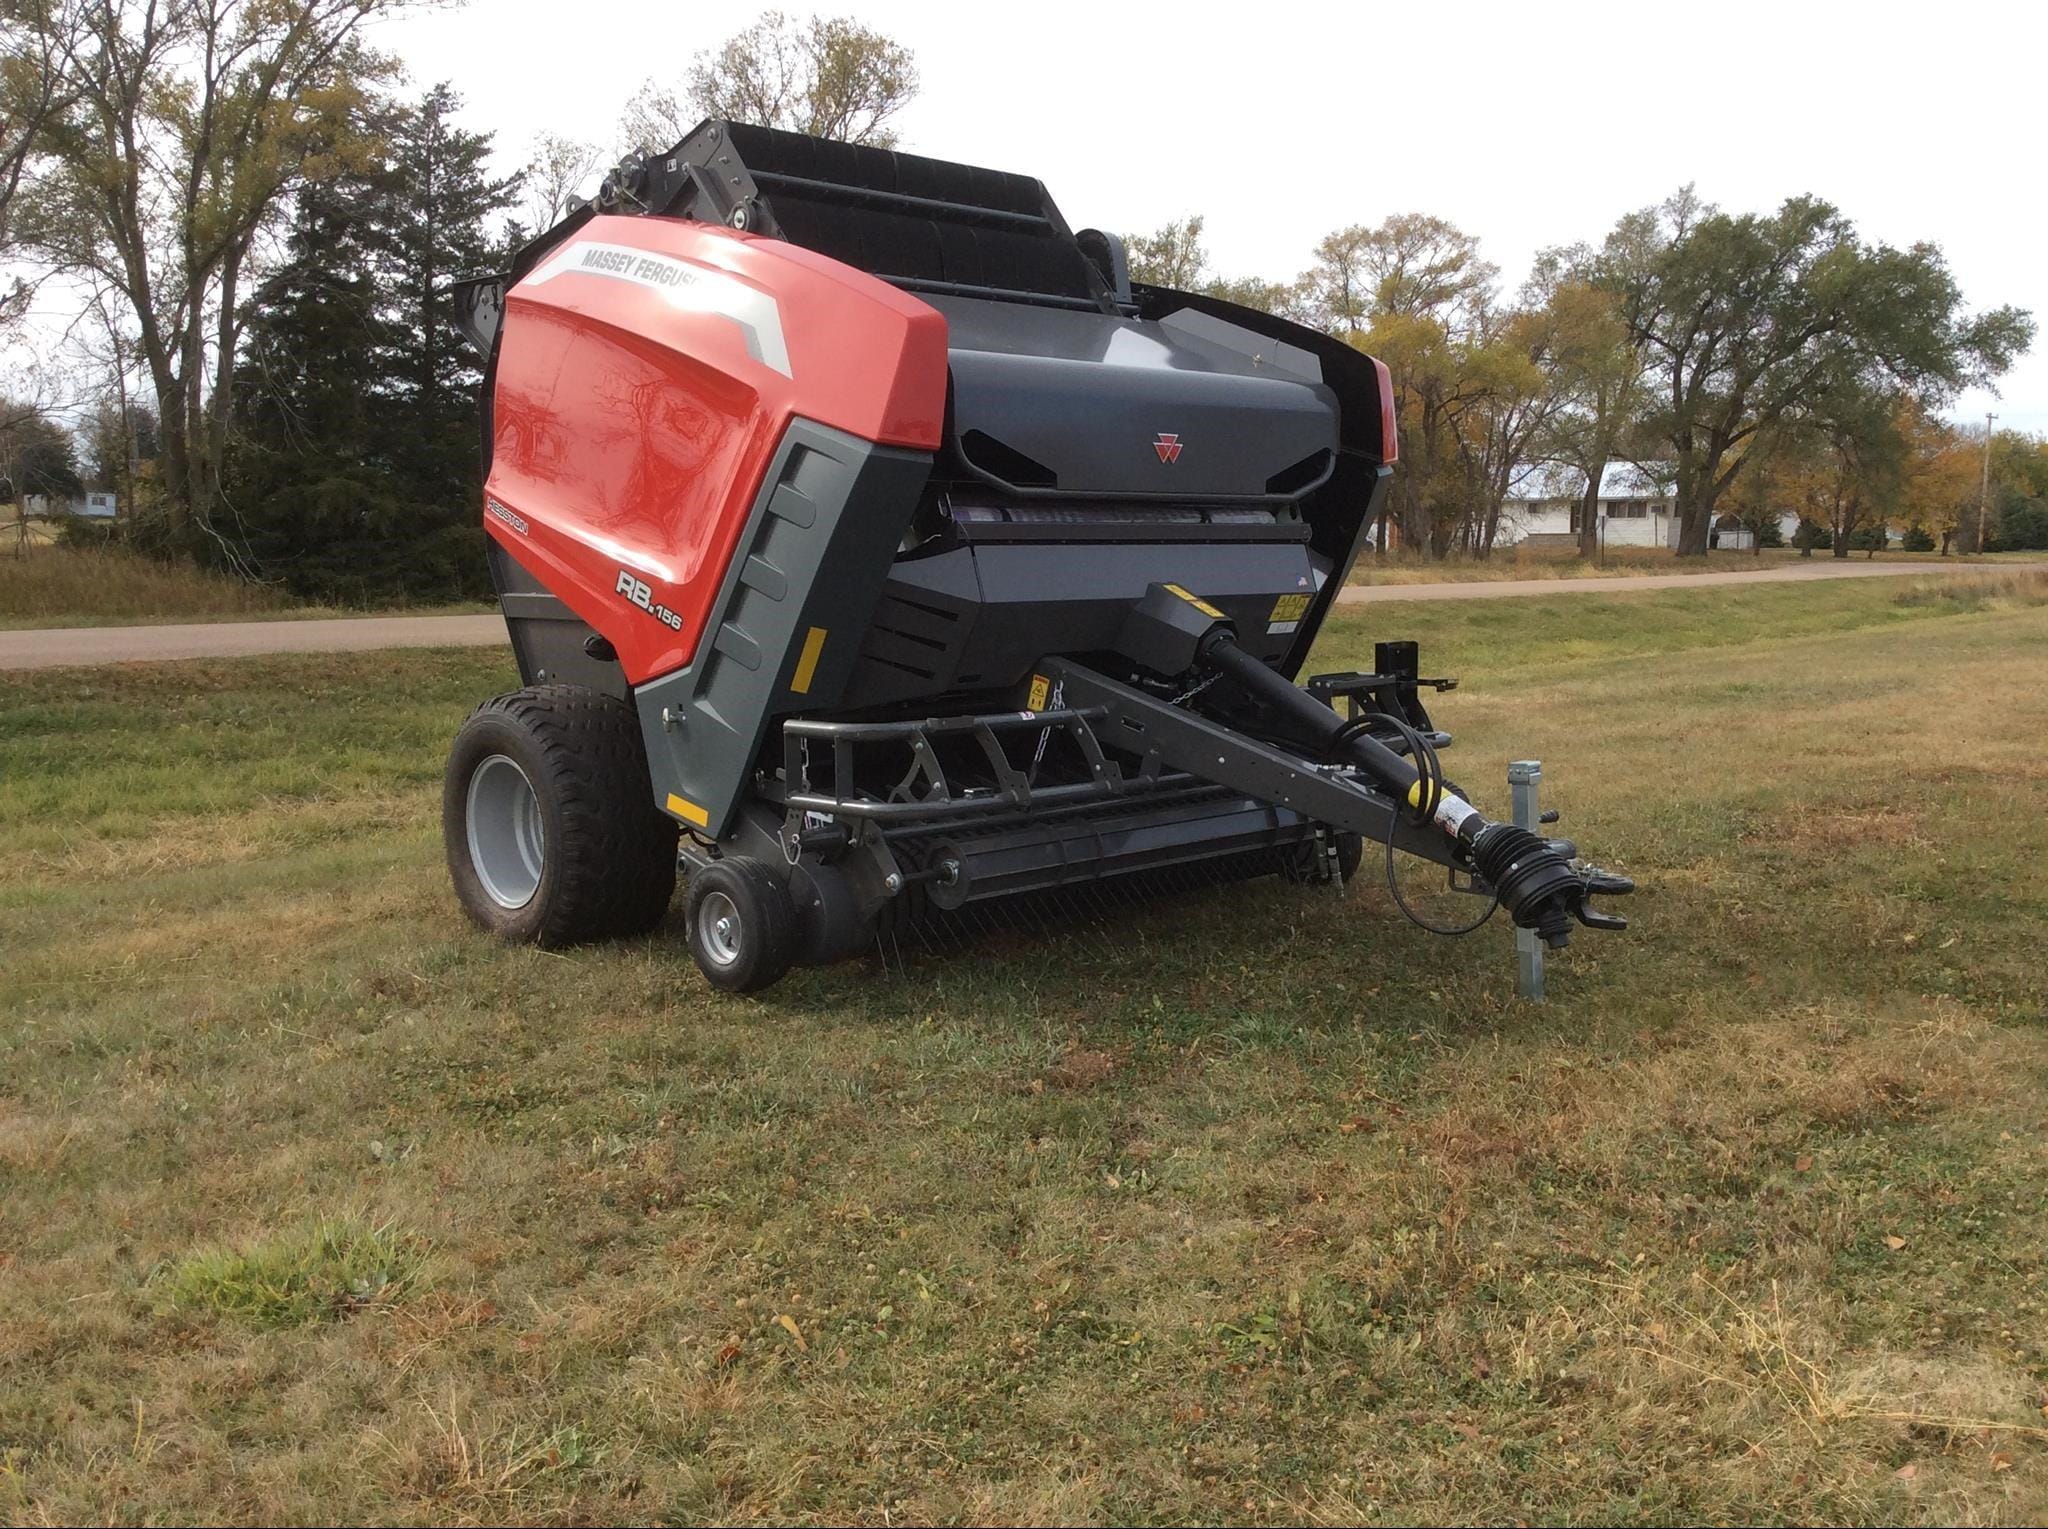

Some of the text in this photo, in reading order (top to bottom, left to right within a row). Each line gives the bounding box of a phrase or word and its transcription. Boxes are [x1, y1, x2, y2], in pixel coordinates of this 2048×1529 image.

[581, 249, 701, 288] MASSEY FERGUS
[487, 496, 529, 536] HESSTON
